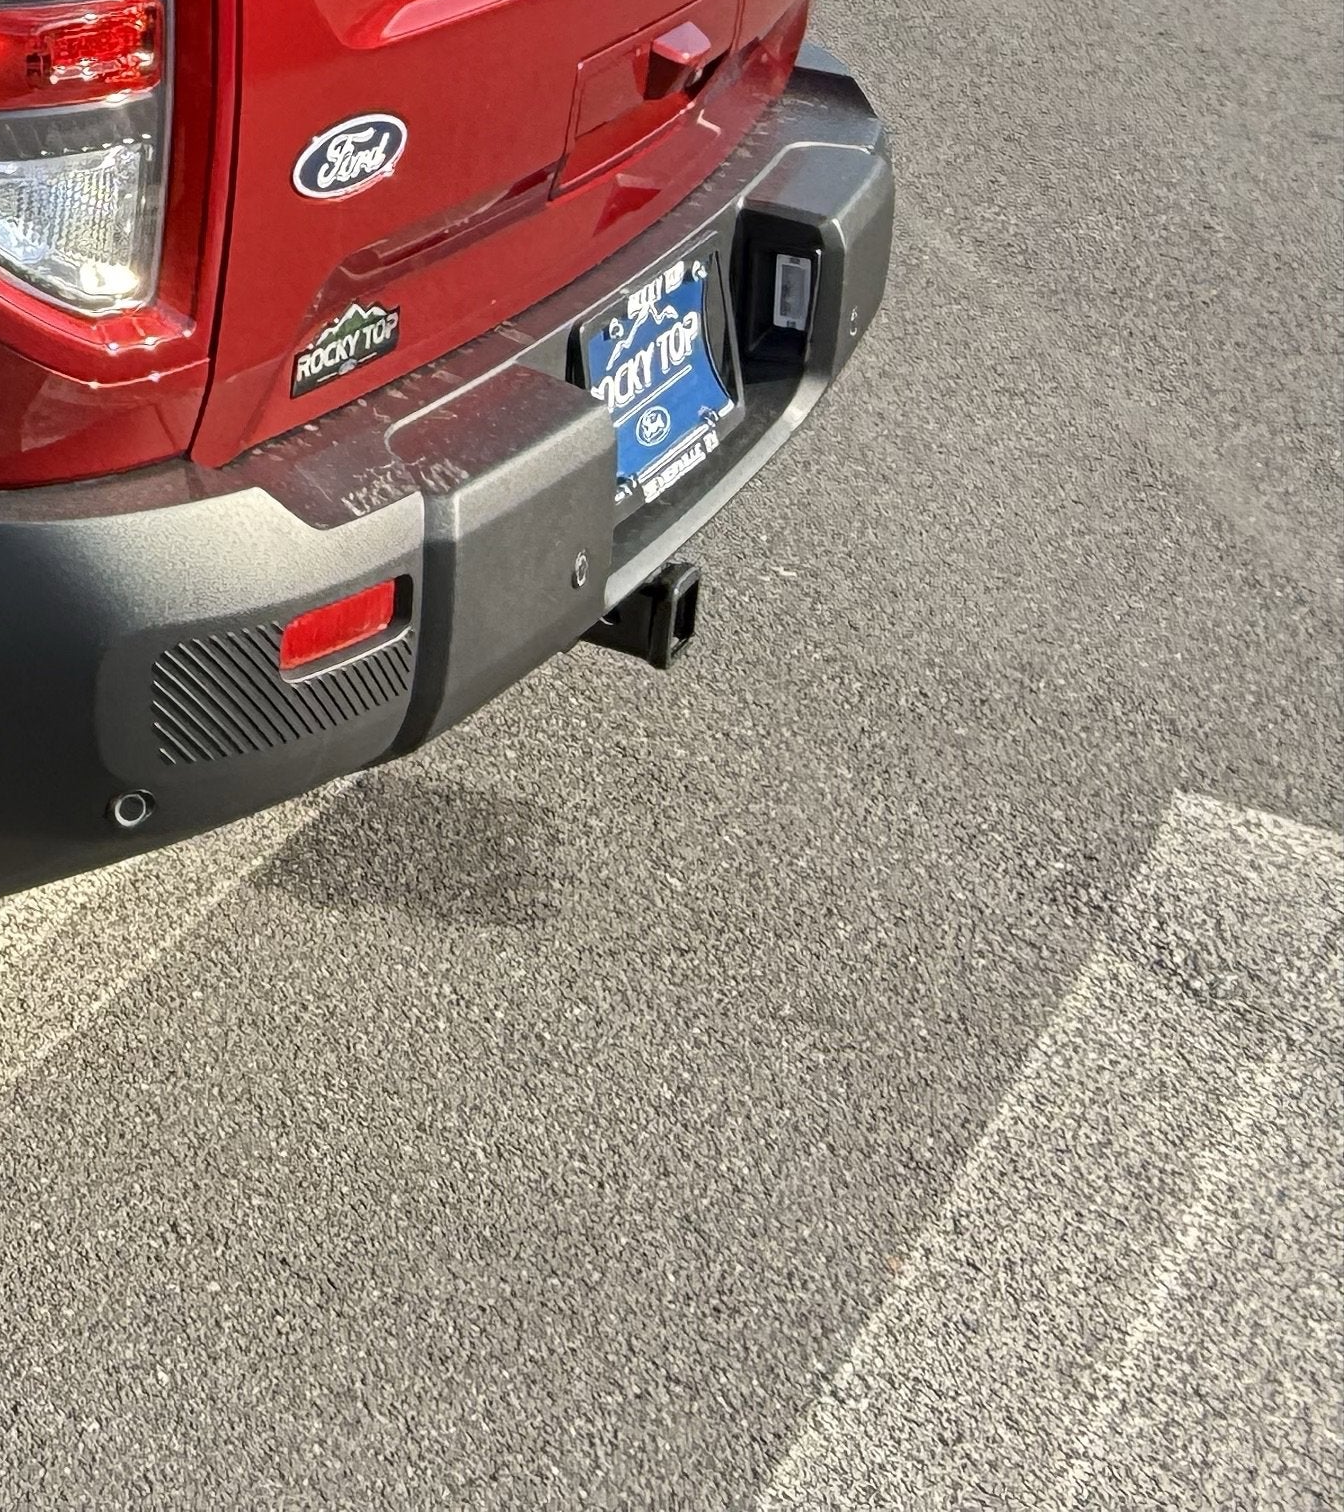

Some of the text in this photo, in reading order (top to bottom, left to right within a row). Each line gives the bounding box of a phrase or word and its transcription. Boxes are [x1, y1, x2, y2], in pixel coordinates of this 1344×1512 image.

[316, 127, 390, 189] Ford
[296, 312, 399, 382] ROCKY TOP
[656, 311, 698, 375] TOP
